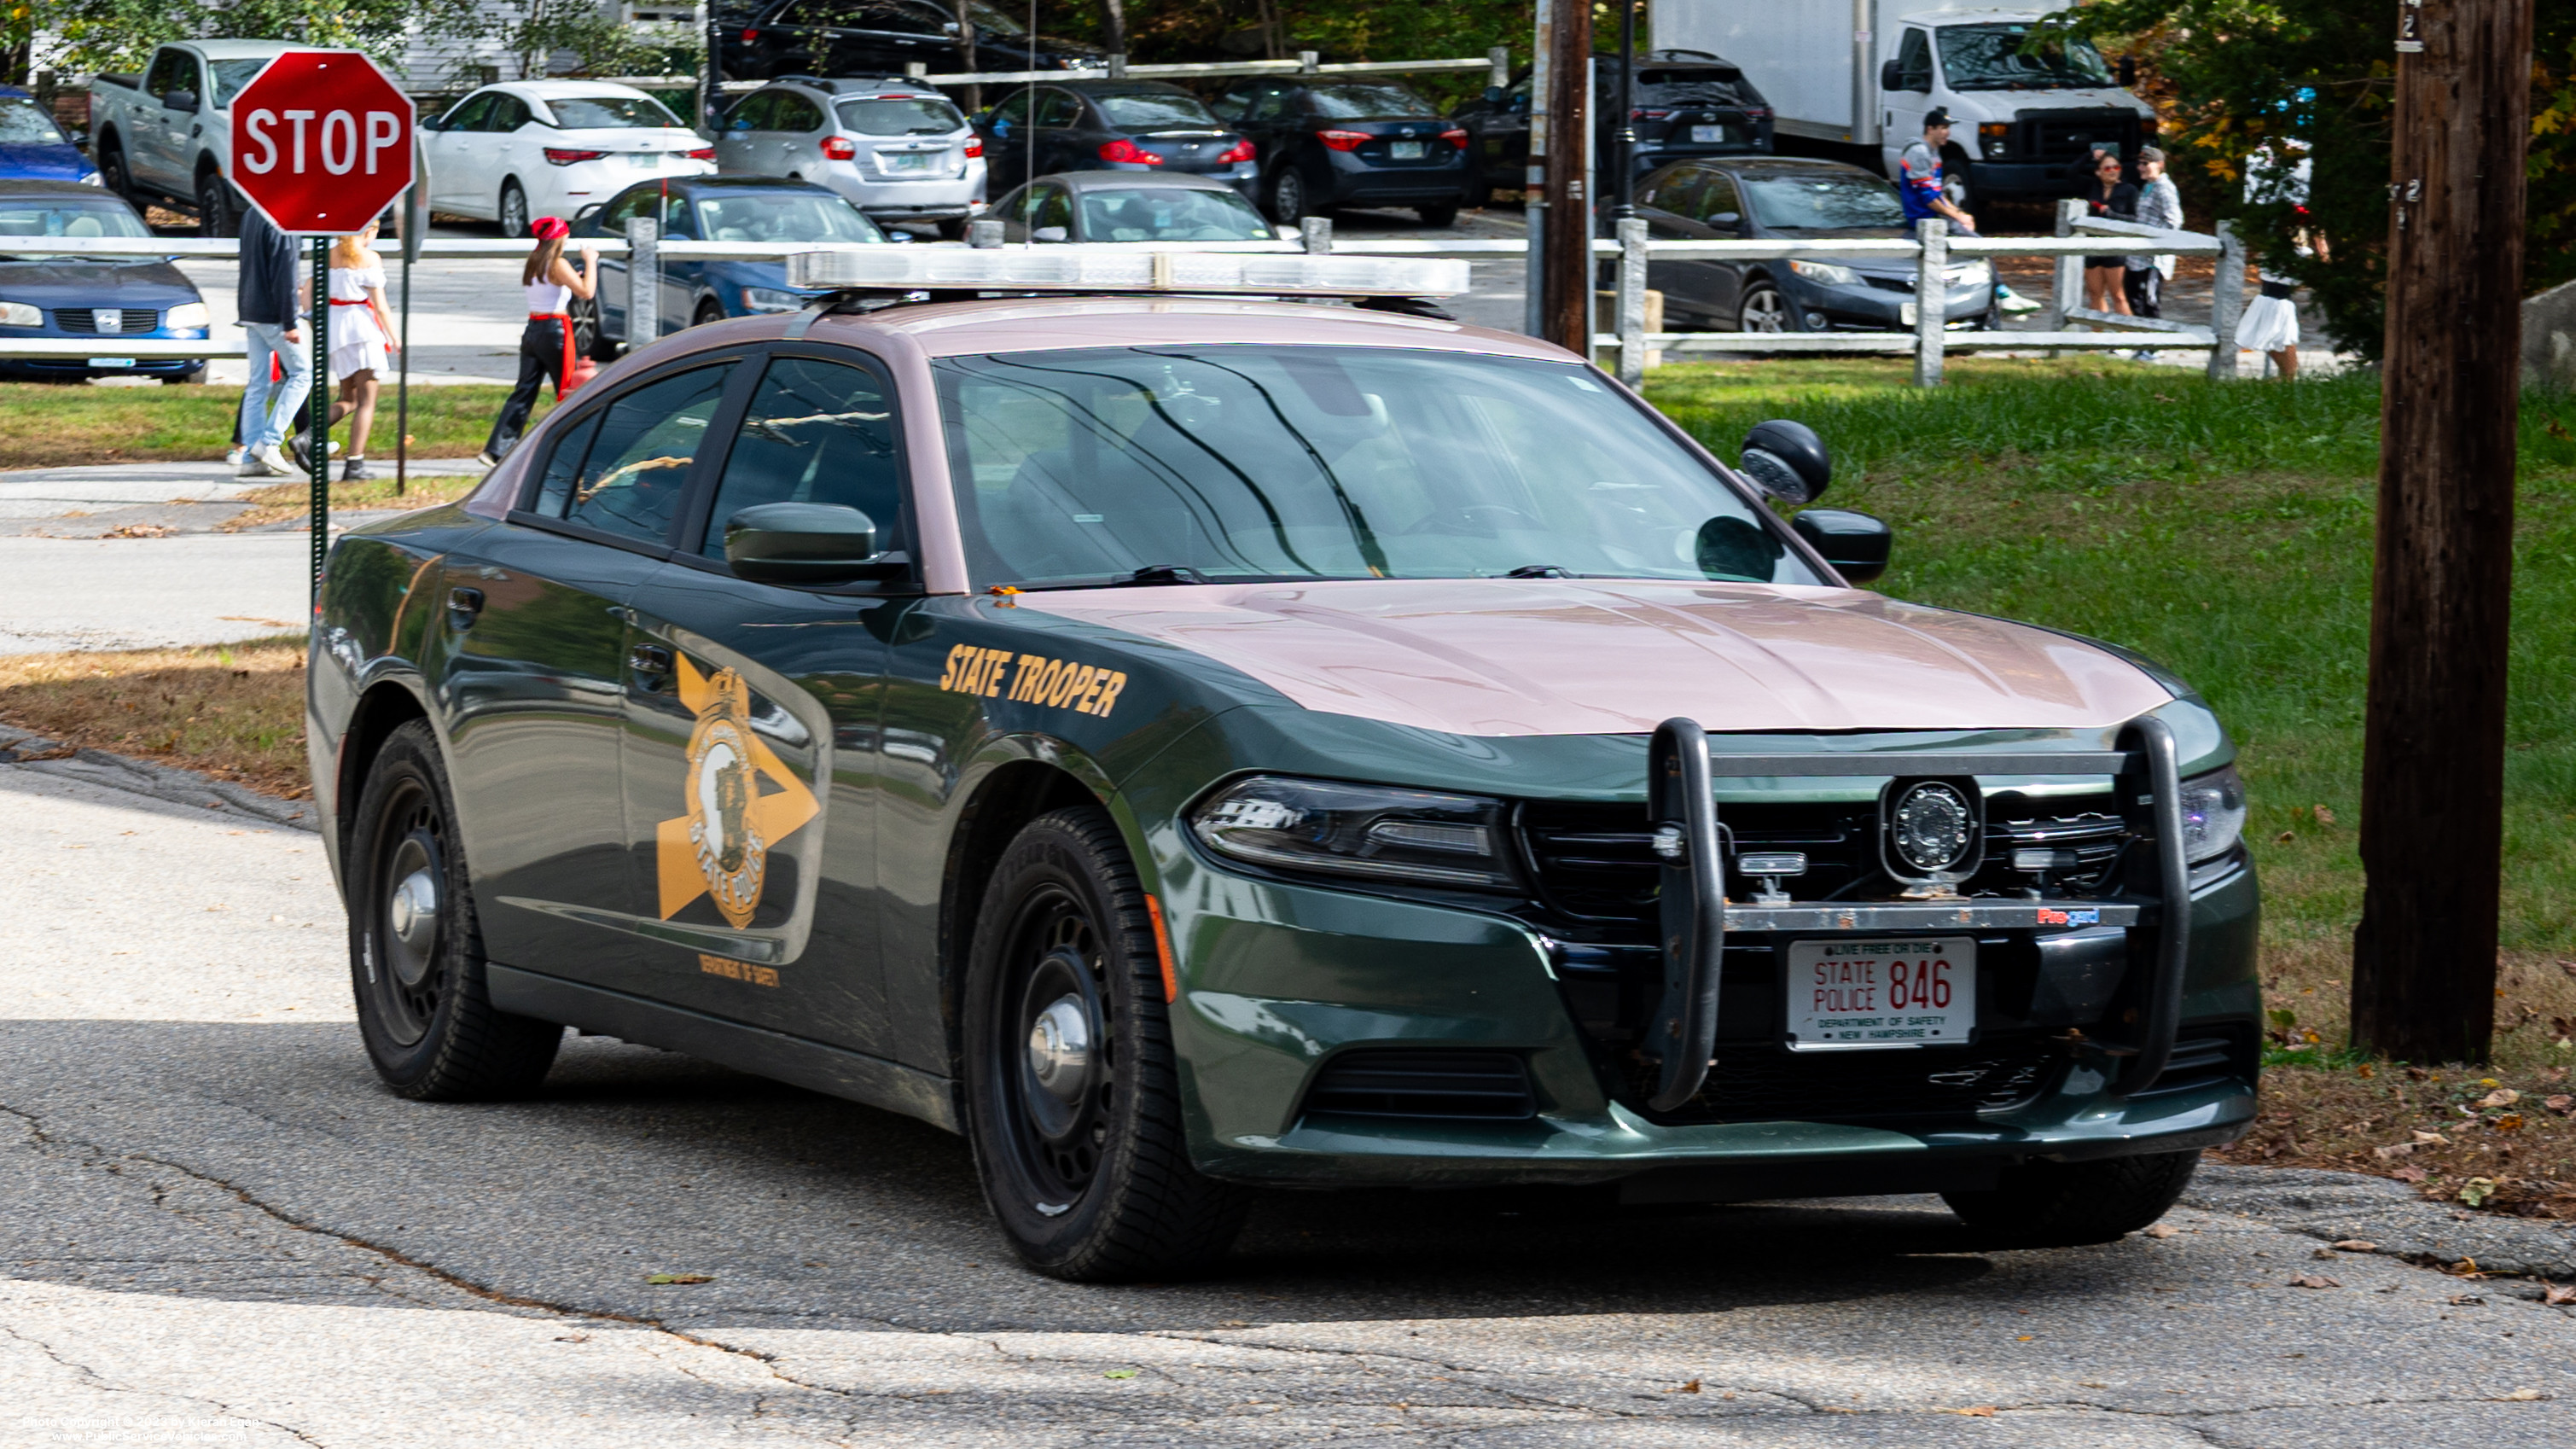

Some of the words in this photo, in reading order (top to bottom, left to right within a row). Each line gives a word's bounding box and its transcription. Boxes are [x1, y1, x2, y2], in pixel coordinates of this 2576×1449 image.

[243, 108, 401, 175] STOP
[940, 643, 1014, 697] STATE
[1007, 654, 1127, 718] TROOPER
[689, 821, 730, 905] STATE
[731, 829, 765, 909] POLICE
[1835, 944, 1859, 955] LIVE
[1862, 943, 1891, 955] FREE
[1893, 943, 1910, 954] OR
[1913, 943, 1932, 953] DIE
[1814, 961, 1876, 985] STATE
[1889, 959, 1951, 1010] 846
[1813, 987, 1876, 1012] POLICE
[1817, 1017, 1883, 1028] DEPARTMENT
[1888, 1016, 1904, 1027] OF
[1907, 1016, 1946, 1026] SAFETY
[1839, 1030, 1862, 1040] NEW
[1869, 1029, 1926, 1039] HAMPSHIRE
